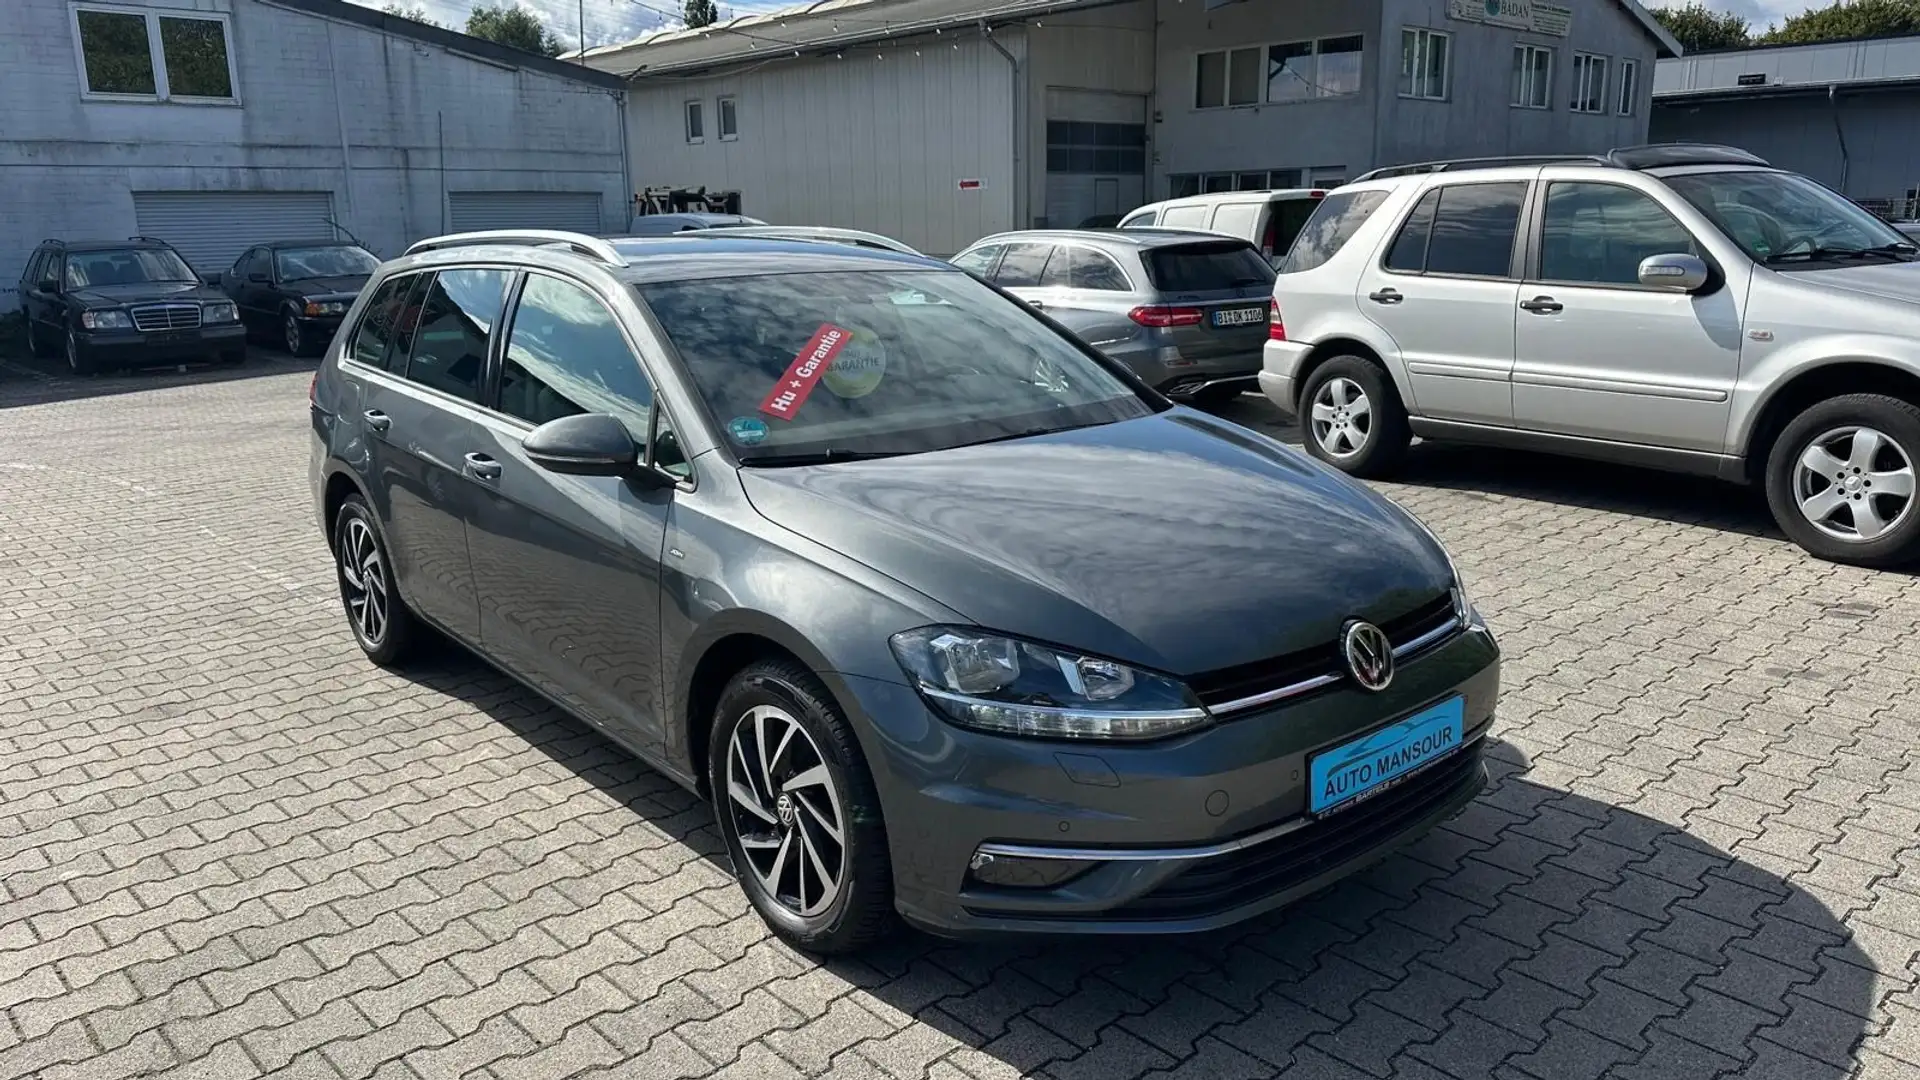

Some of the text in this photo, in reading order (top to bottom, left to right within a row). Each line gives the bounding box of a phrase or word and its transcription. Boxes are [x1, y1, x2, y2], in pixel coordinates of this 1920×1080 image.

[1501, 1, 1529, 18] BADAN
[770, 389, 797, 412] Hu
[795, 329, 842, 379] Garantie
[1324, 765, 1372, 800] AUTO
[1377, 725, 1453, 777] MANSOUR
